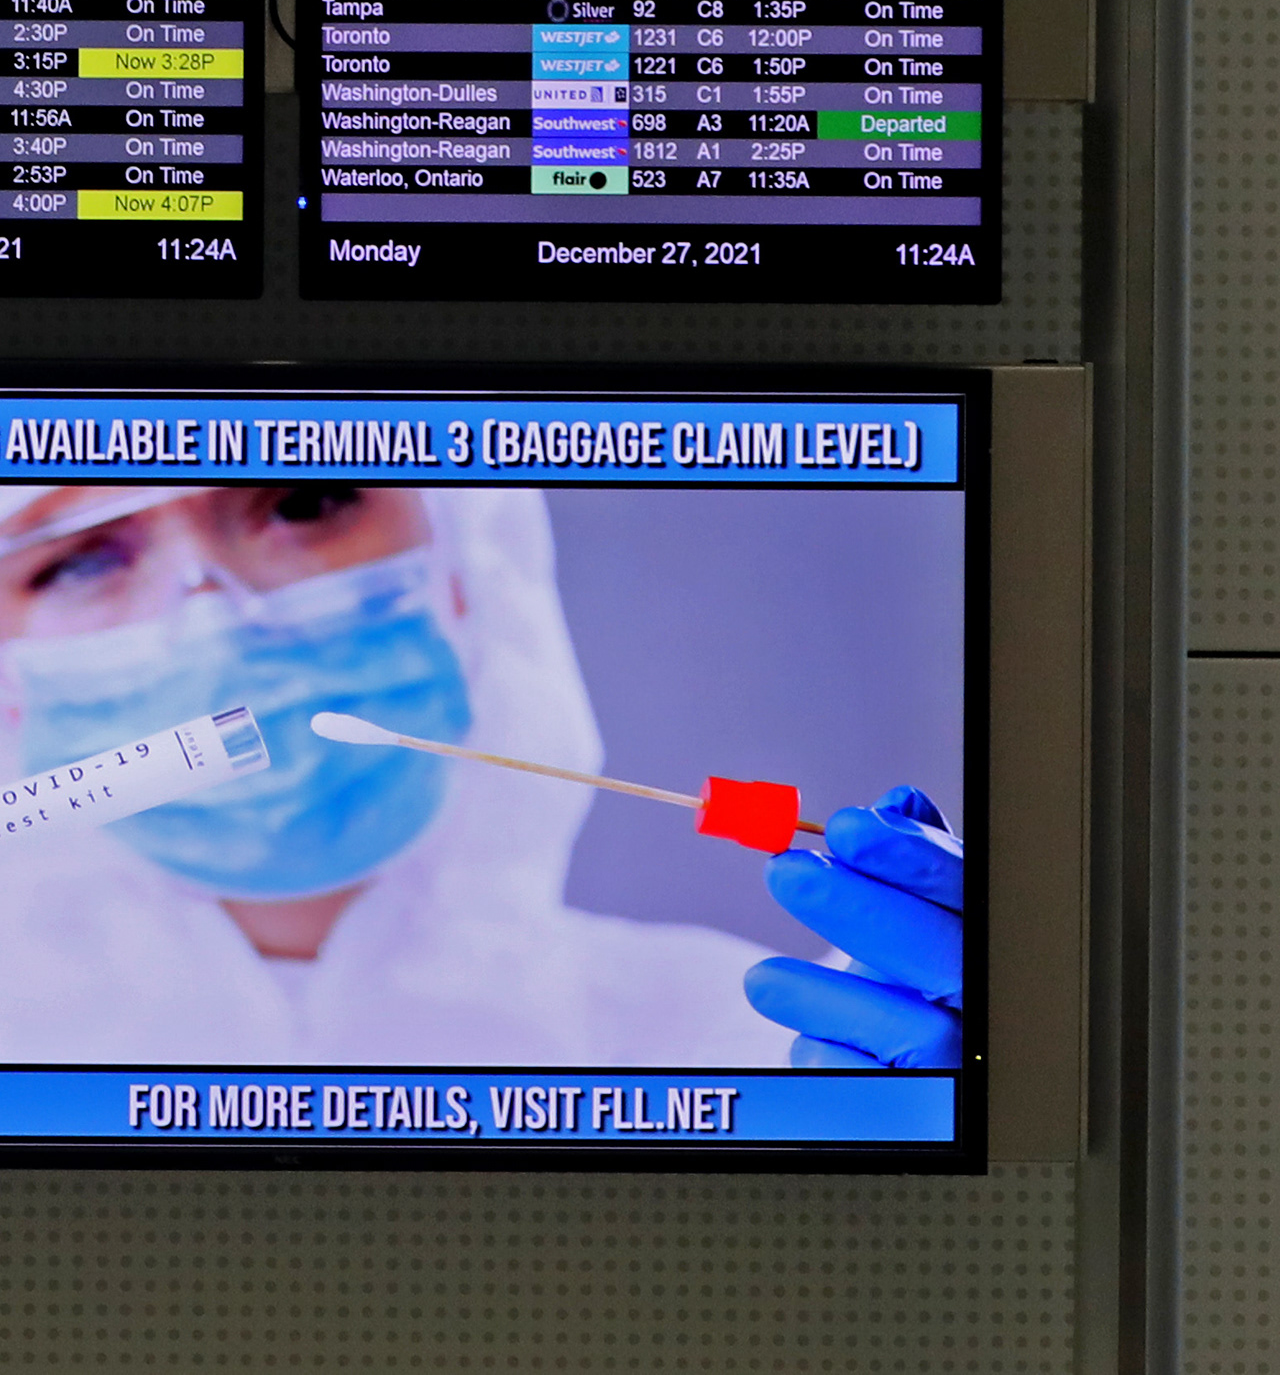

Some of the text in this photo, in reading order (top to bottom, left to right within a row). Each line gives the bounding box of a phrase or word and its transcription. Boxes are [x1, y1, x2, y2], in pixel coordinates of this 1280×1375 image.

[322, 27, 943, 49] Toronto WESTJET 1231 C6 12:00P On Time
[322, 170, 944, 190] Waterloo, Ontario flair 523 A7 11:35A On Time
[330, 240, 975, 267] Monday December 27, 2021 11:24A
[5, 417, 201, 465] AVAILABLE
[208, 418, 246, 465] IN
[254, 418, 441, 468] TERMINAL
[446, 419, 476, 468] 3
[482, 418, 664, 471] (BAGGAGE
[671, 419, 787, 468] CLAIM
[795, 419, 921, 470] LEVEL)
[69, 785, 113, 810] kit
[128, 1084, 739, 1137] FOR MORE DETAILS, VISIT FLL.NET
